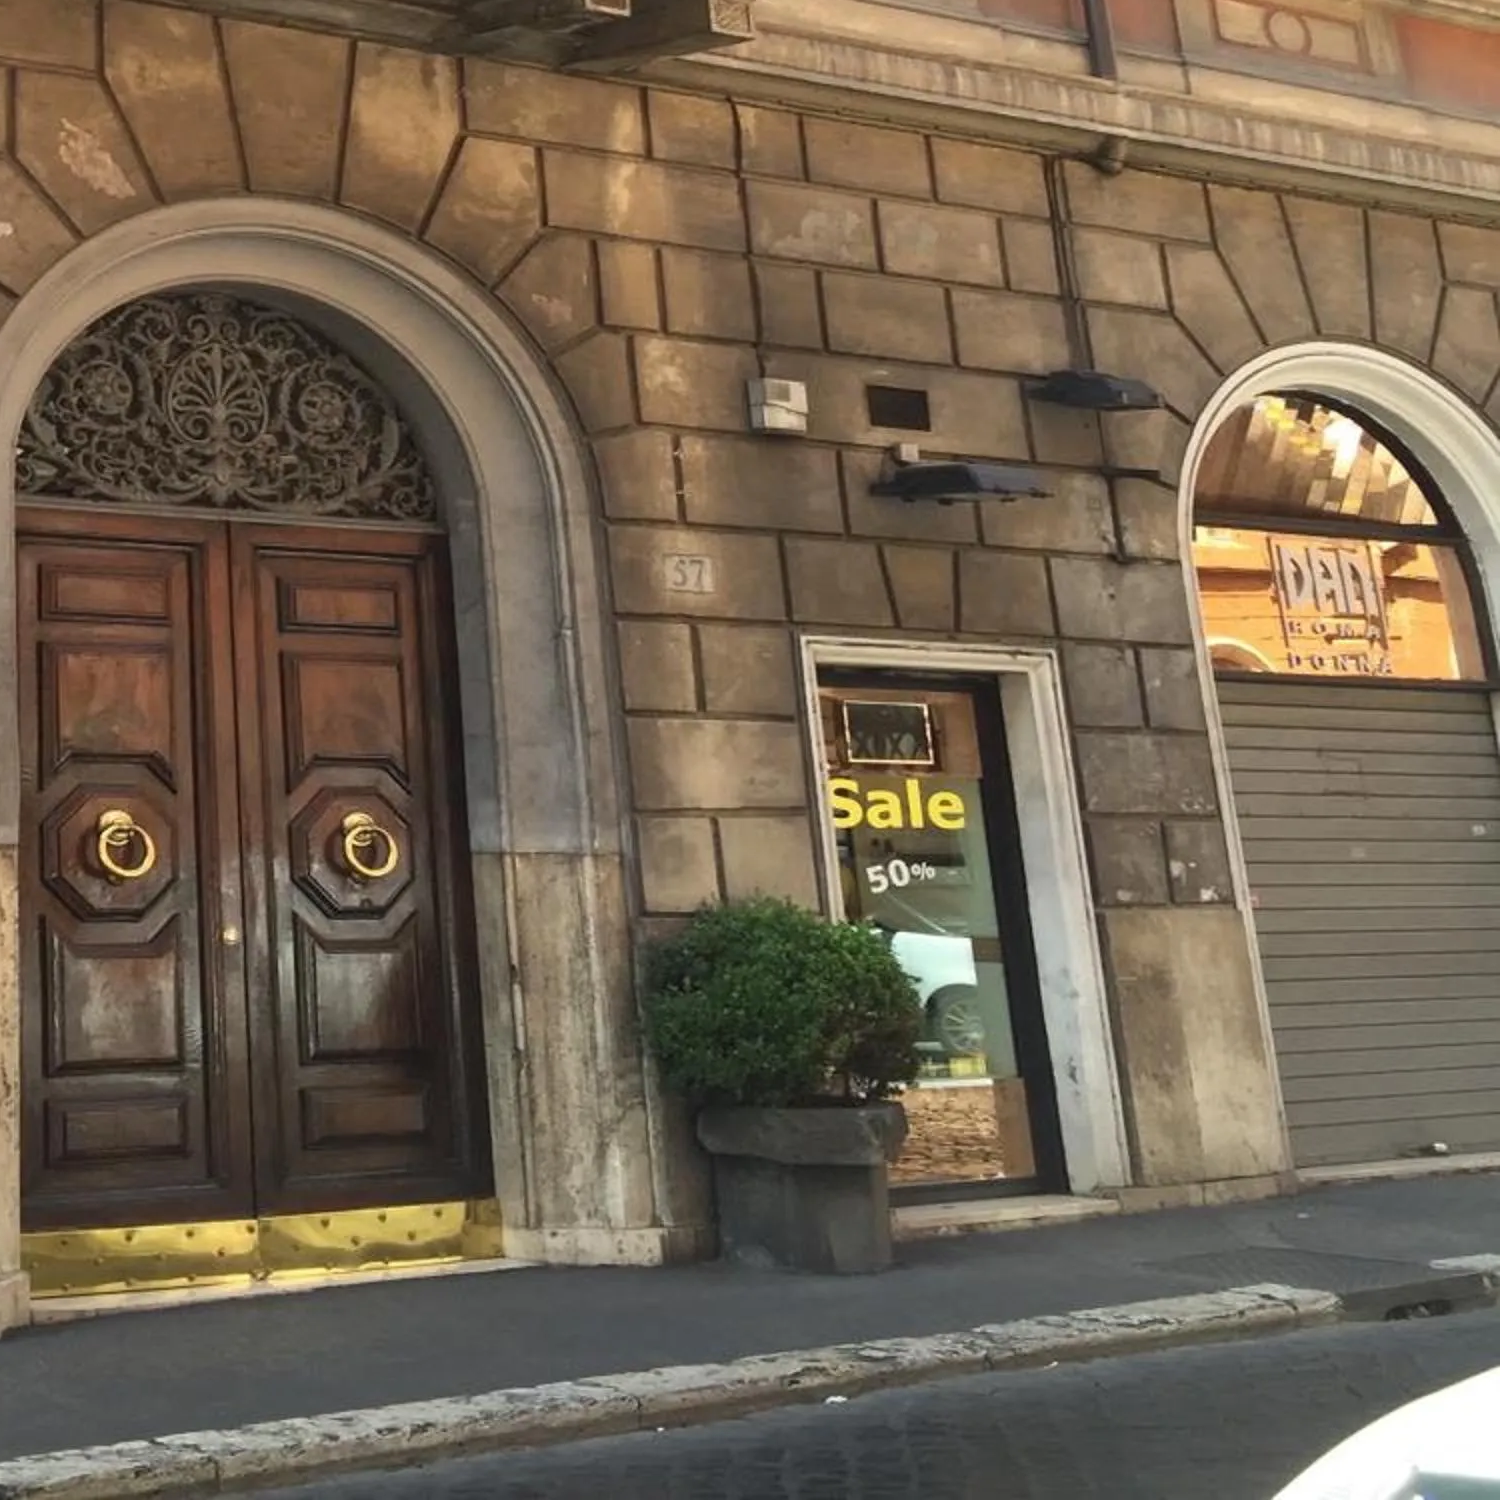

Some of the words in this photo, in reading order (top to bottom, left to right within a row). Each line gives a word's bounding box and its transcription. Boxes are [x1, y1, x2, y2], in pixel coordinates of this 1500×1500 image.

[672, 559, 705, 590] 57
[827, 777, 966, 830] Sale
[865, 858, 937, 895] 50%
